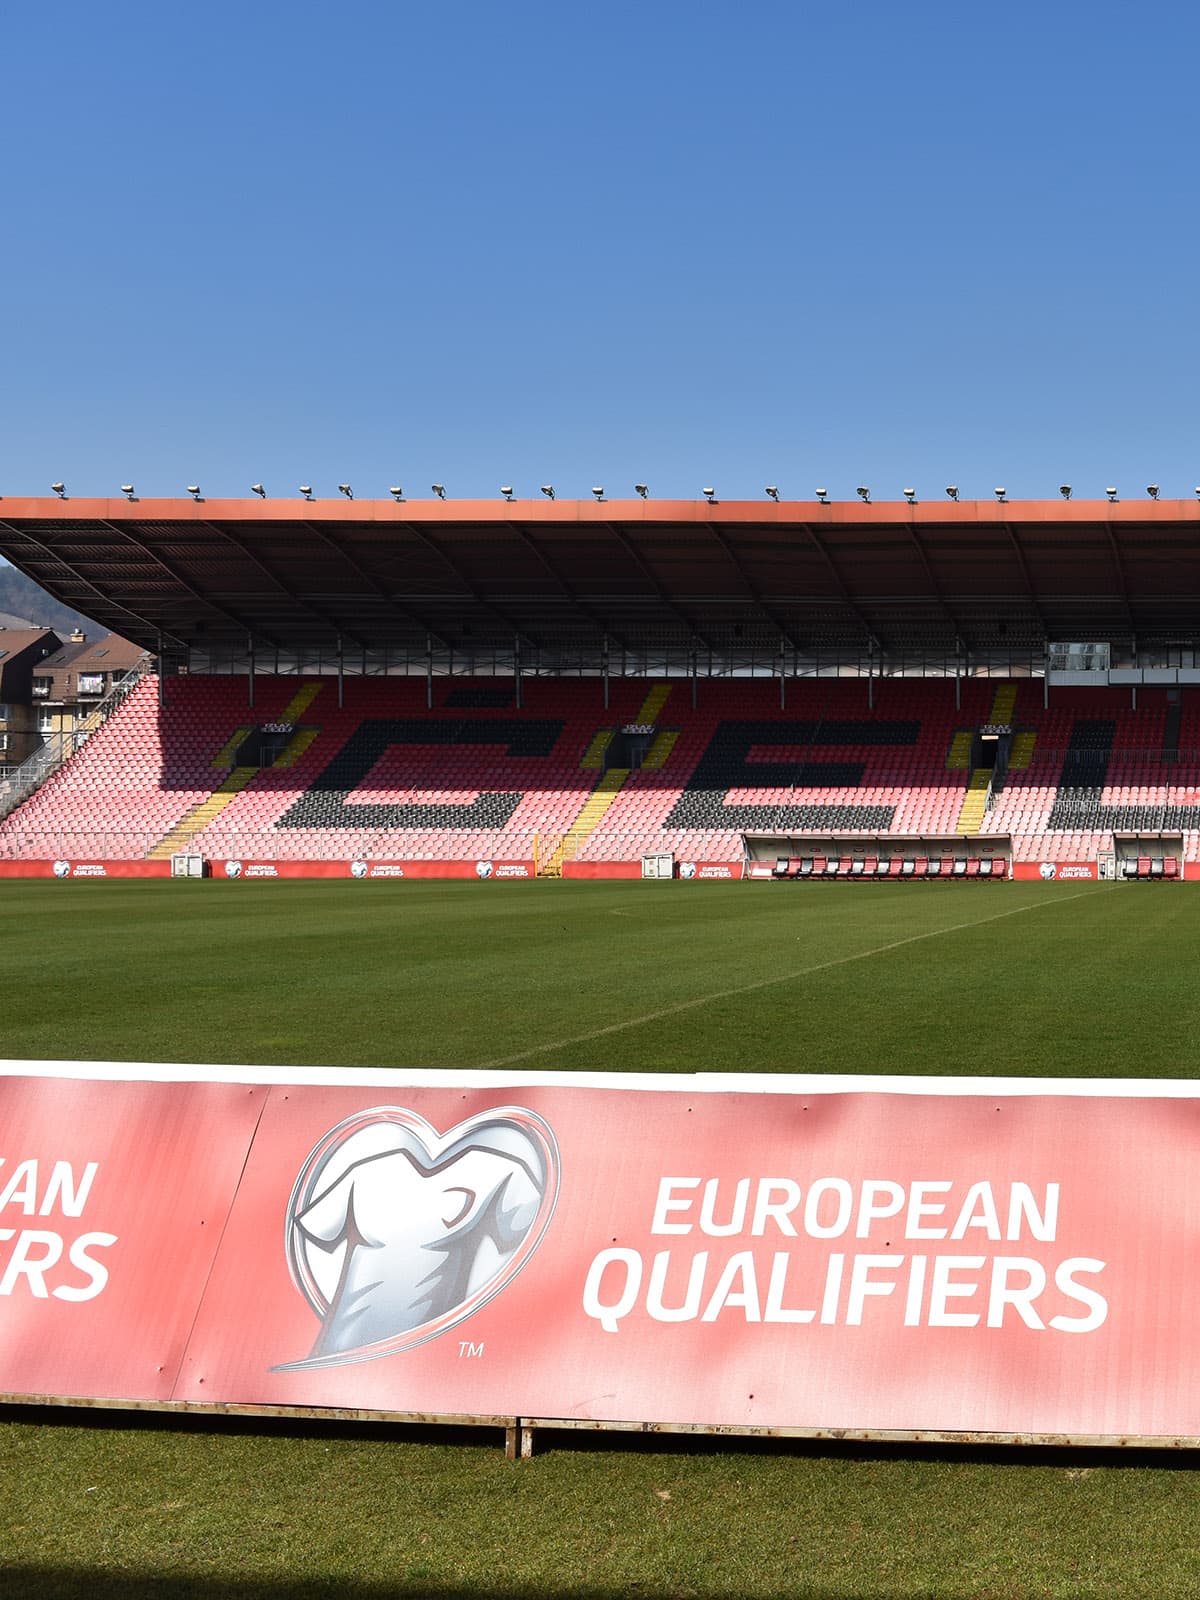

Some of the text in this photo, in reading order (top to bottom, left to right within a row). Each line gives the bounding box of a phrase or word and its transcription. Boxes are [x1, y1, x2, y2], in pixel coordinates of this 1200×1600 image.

[0, 1158, 99, 1218] AN
[650, 1176, 1061, 1243] EUROPEAN
[582, 1246, 1109, 1334] QUALIFIERS
[458, 1342, 485, 1358] TM
